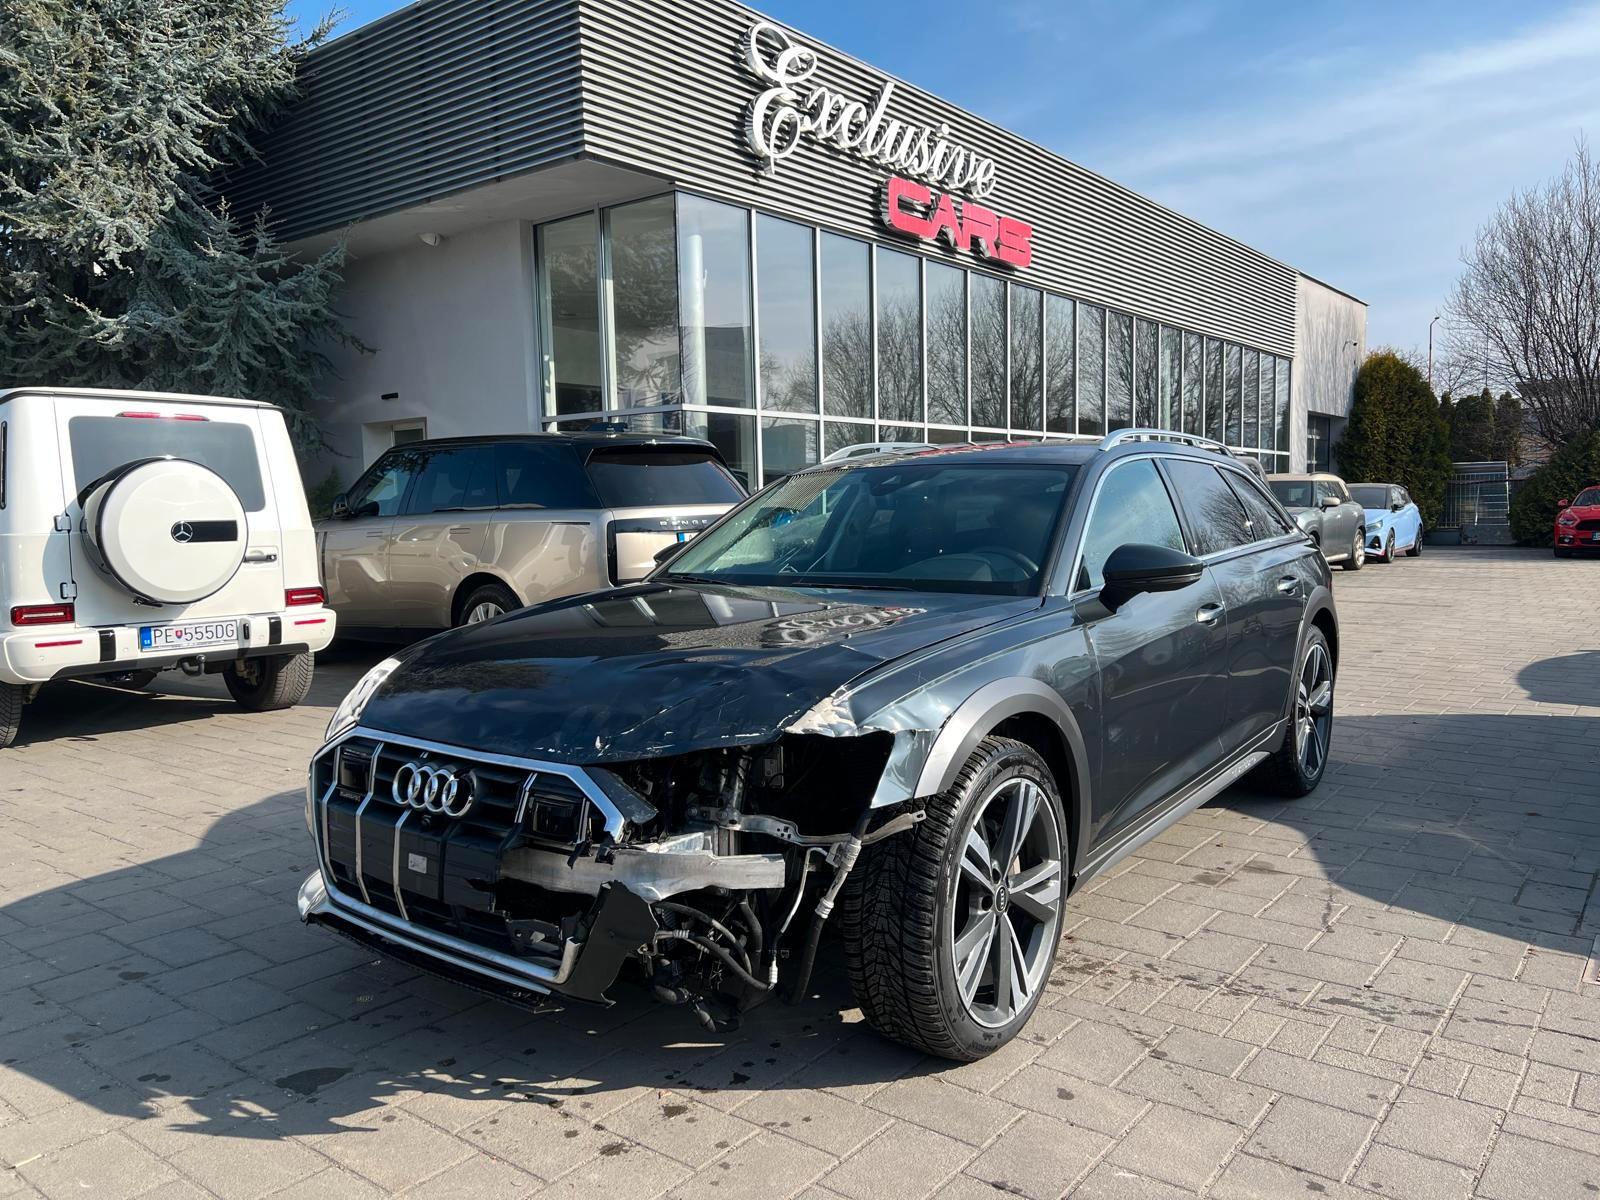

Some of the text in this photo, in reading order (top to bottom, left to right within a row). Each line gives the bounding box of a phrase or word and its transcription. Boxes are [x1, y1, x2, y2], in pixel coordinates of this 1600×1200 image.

[748, 22, 996, 199] Exclusive
[886, 177, 1033, 268] CARS
[153, 623, 235, 644] PE 555DG
